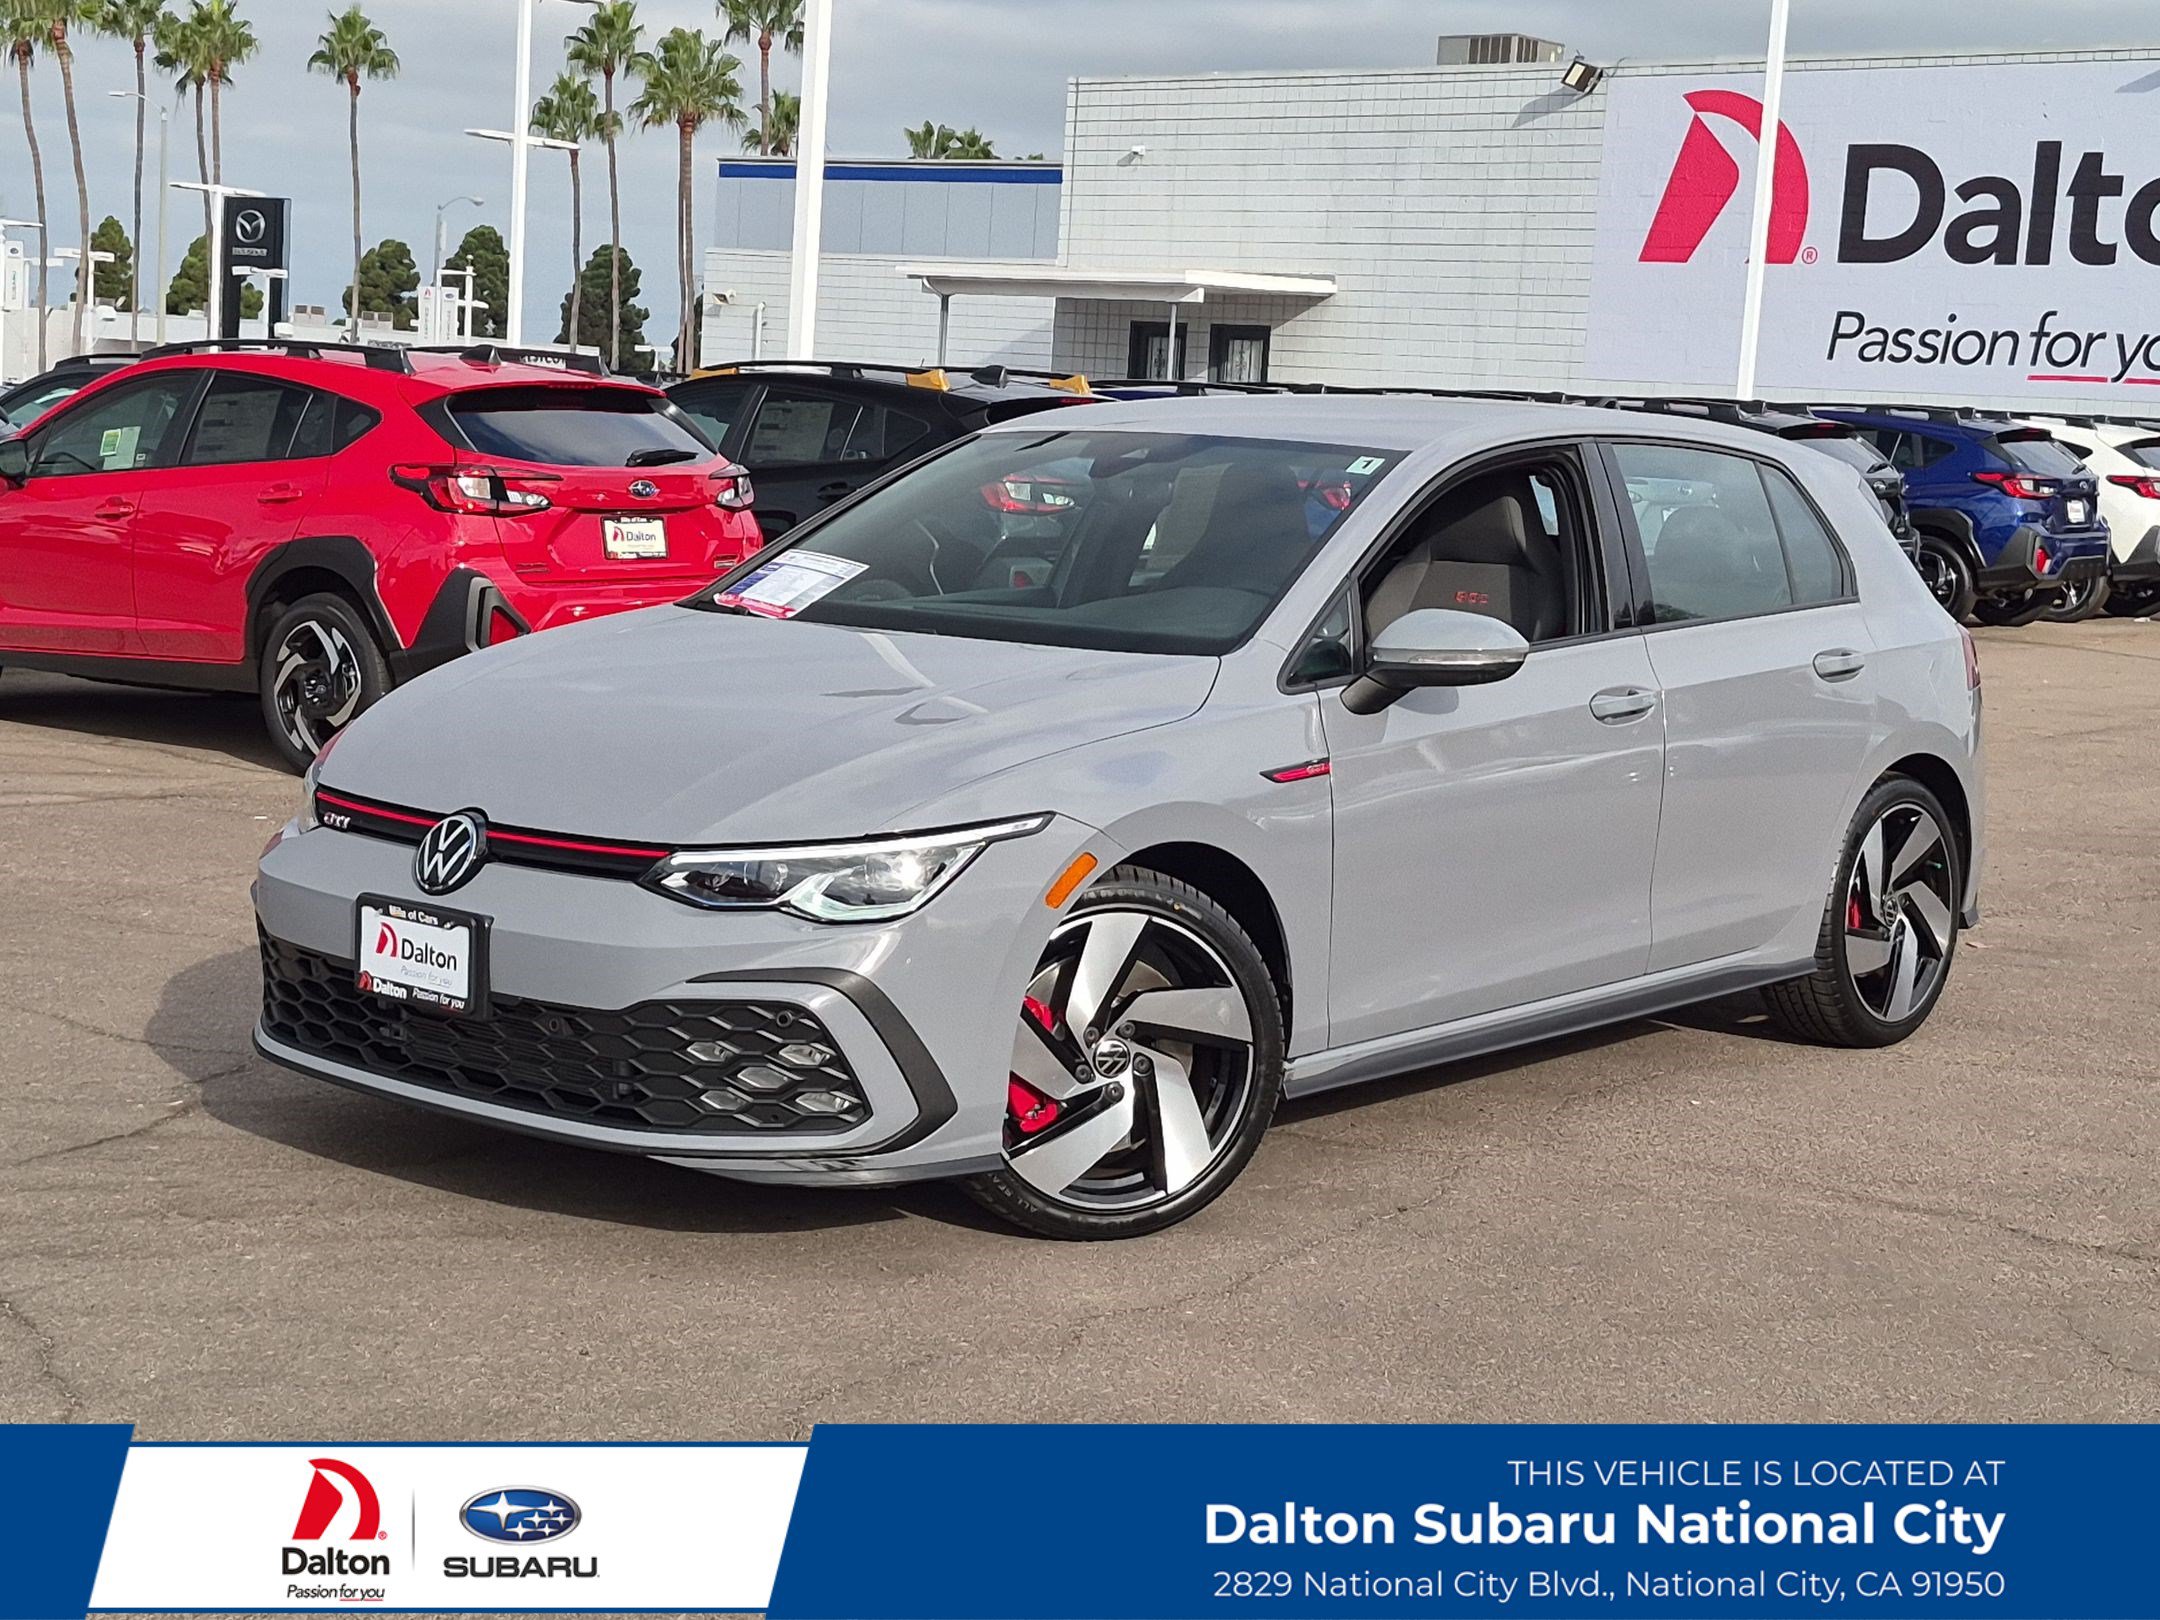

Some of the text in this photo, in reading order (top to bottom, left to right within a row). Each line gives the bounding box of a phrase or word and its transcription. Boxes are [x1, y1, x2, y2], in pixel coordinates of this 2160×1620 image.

[1827, 311, 2020, 367] Passion
[2029, 310, 2107, 368] for
[626, 530, 656, 542] Dalton
[407, 909, 417, 921] of
[418, 911, 439, 925] Cars
[401, 937, 457, 971] Dalton
[400, 965, 427, 980] Passion
[373, 977, 465, 1010] Dalton Passion for you
